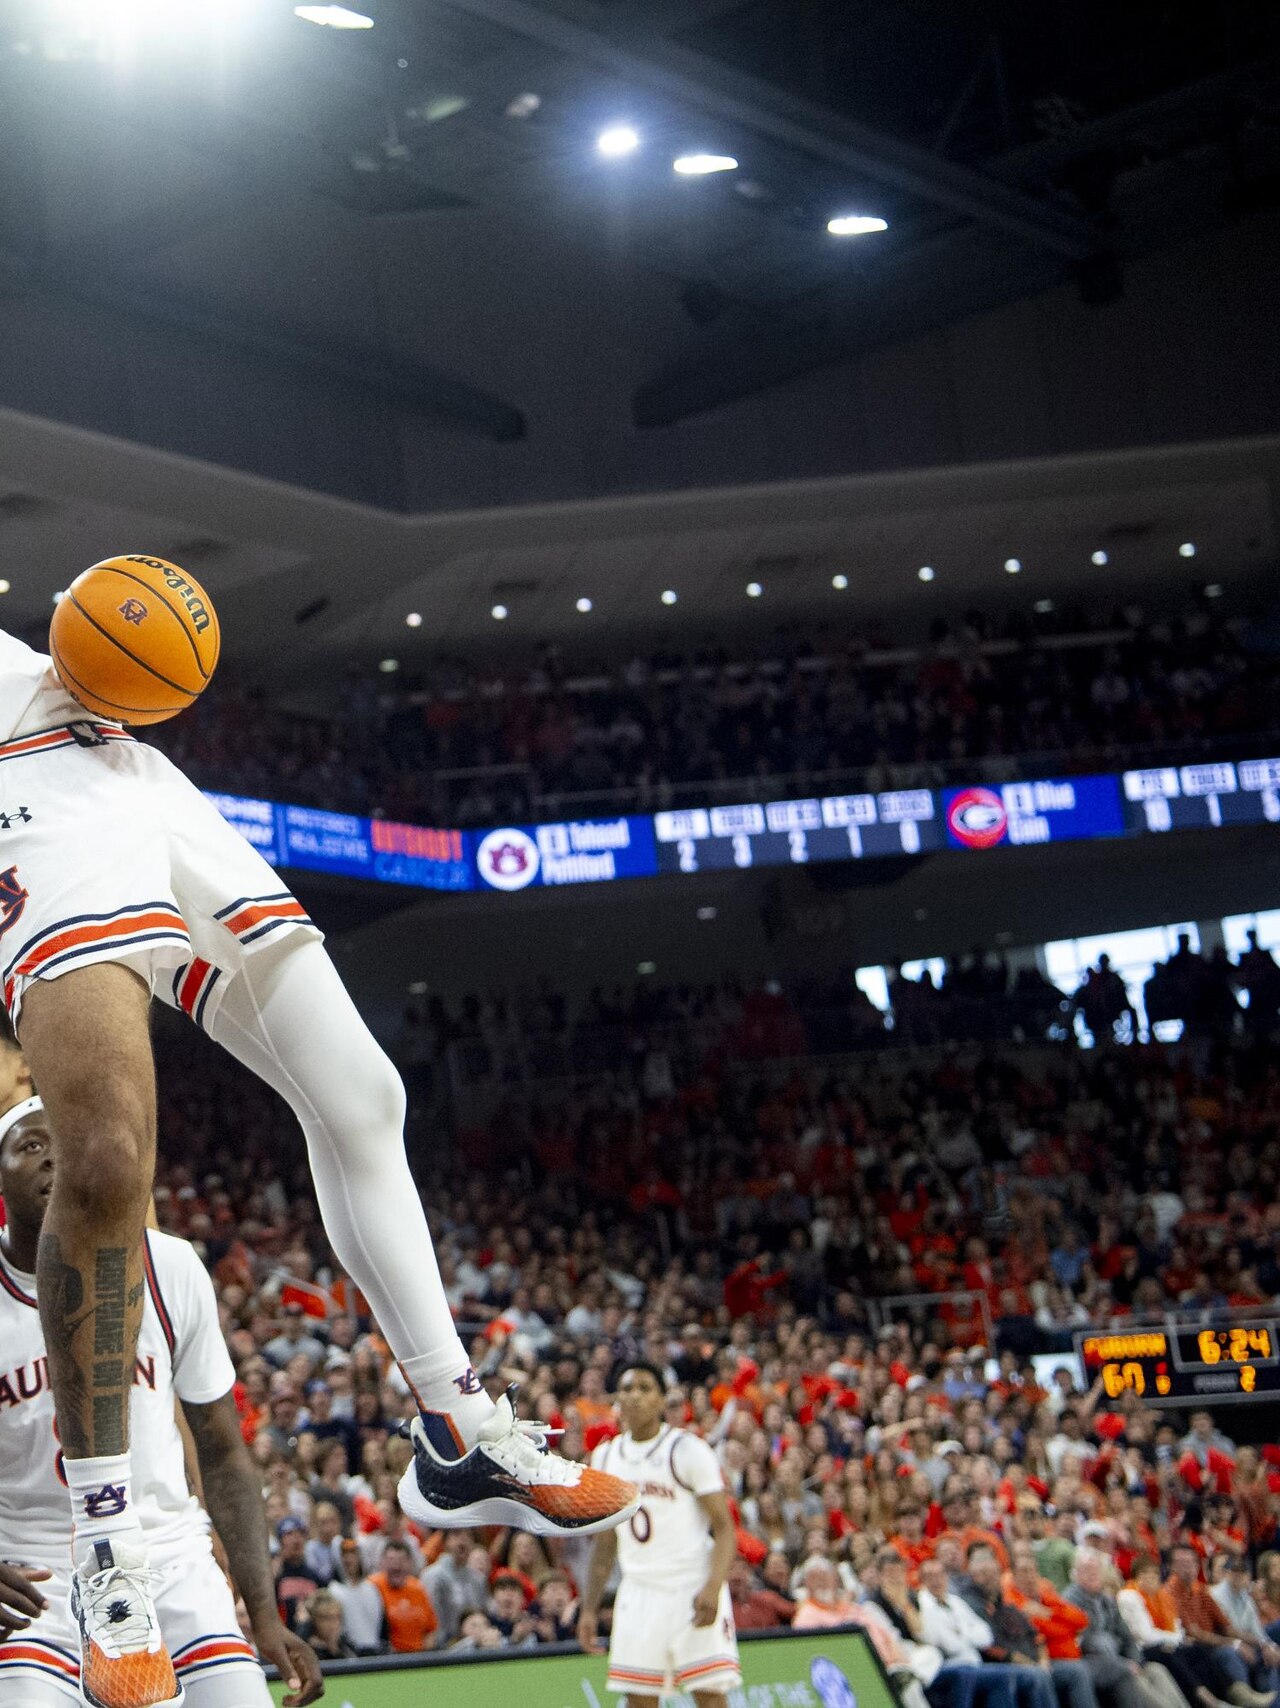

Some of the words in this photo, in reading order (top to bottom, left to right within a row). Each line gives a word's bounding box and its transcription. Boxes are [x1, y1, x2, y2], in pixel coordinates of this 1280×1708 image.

[126, 556, 210, 635] Wilson
[1197, 1328, 1271, 1365] 6:24
[630, 1504, 651, 1544] 0
